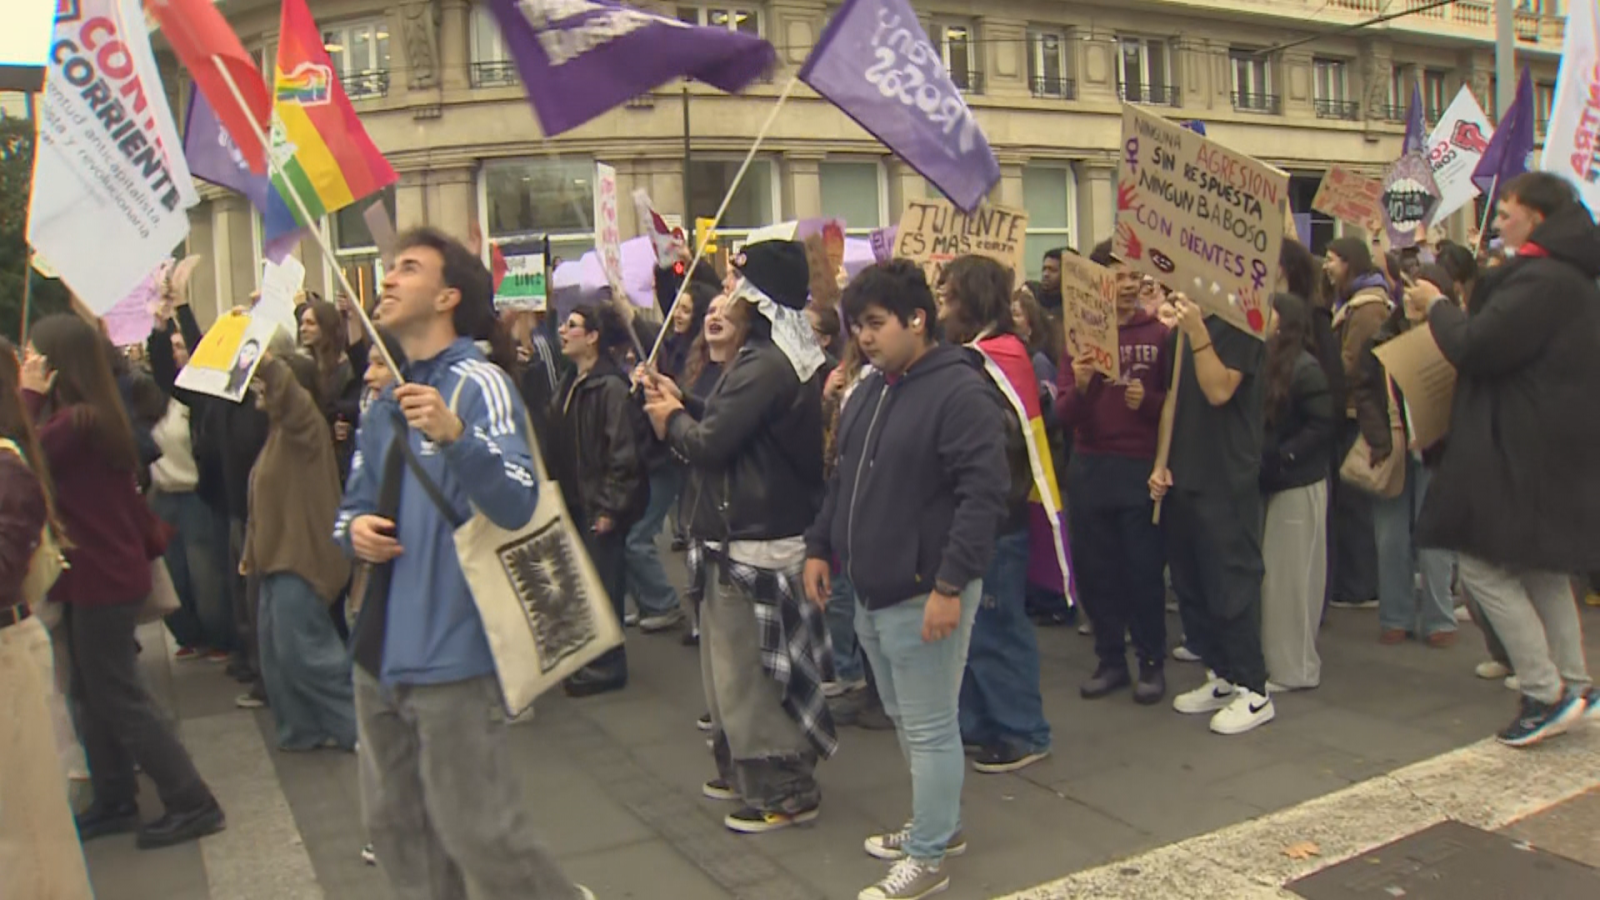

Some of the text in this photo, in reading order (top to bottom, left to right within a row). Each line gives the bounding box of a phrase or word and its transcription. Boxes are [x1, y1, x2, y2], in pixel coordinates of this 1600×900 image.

[51, 39, 181, 212] CORRIENTE
[1134, 116, 1182, 150] NINGUNA
[1196, 143, 1278, 206] AGRESION
[909, 202, 949, 234] TU
[1139, 168, 1195, 214] NINGUN
[1197, 195, 1267, 253] BABOSO
[1152, 147, 1263, 222] SIN RESPUESTA
[901, 232, 926, 256] ES
[931, 233, 971, 255] MAS
[1136, 204, 1246, 278] CON DIENTES
